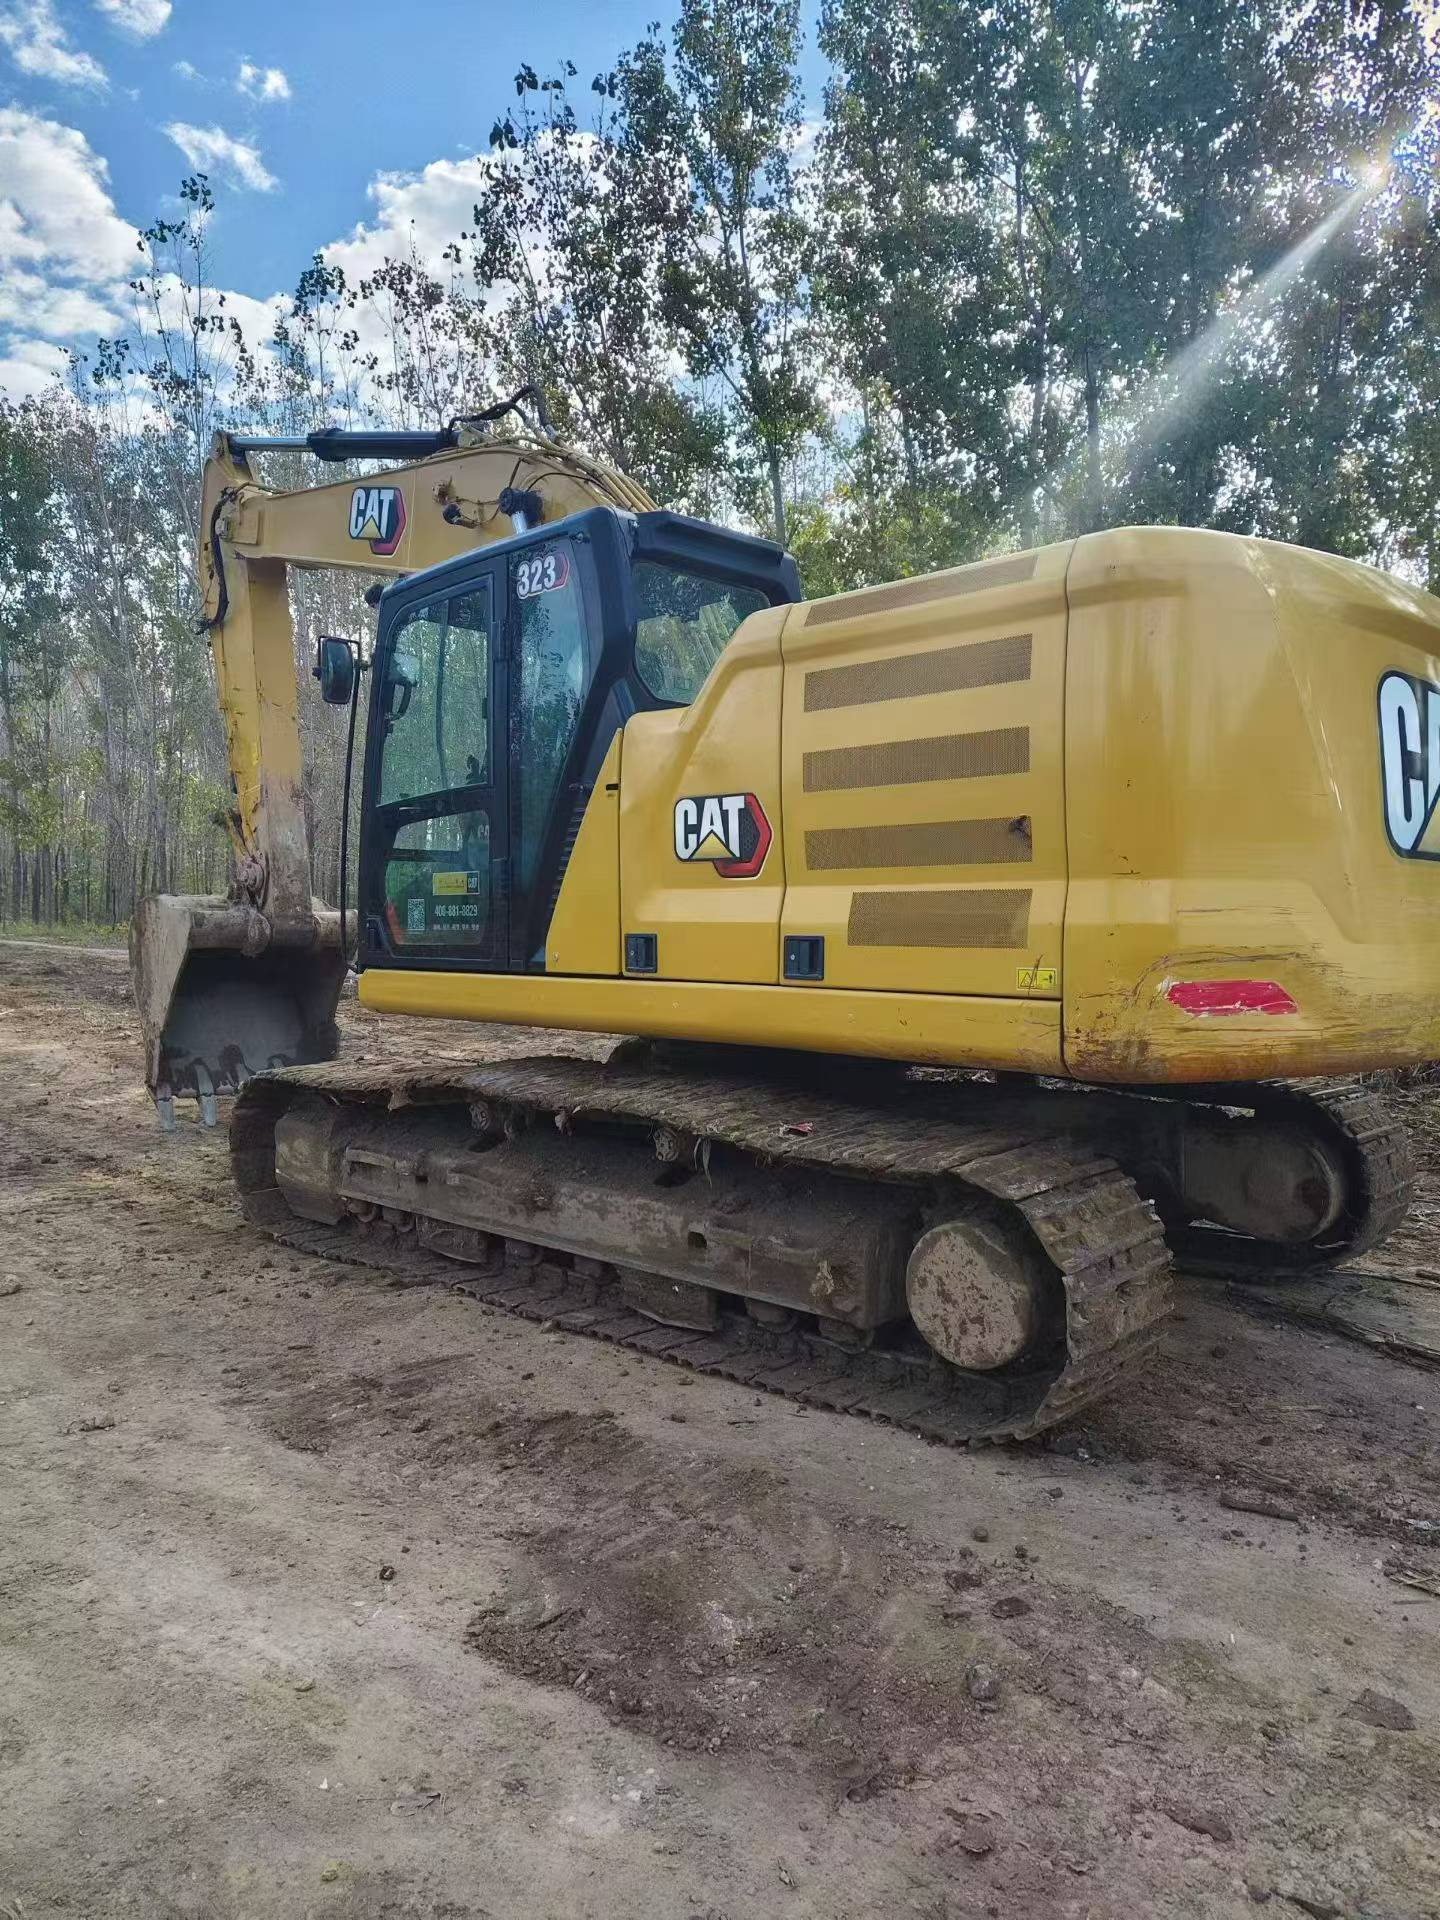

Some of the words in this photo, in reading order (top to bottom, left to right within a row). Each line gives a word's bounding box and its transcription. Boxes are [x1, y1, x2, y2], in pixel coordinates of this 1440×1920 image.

[349, 488, 395, 539] CAT
[518, 555, 556, 597] 323
[1379, 675, 1440, 852] C
[674, 795, 745, 860] CAT
